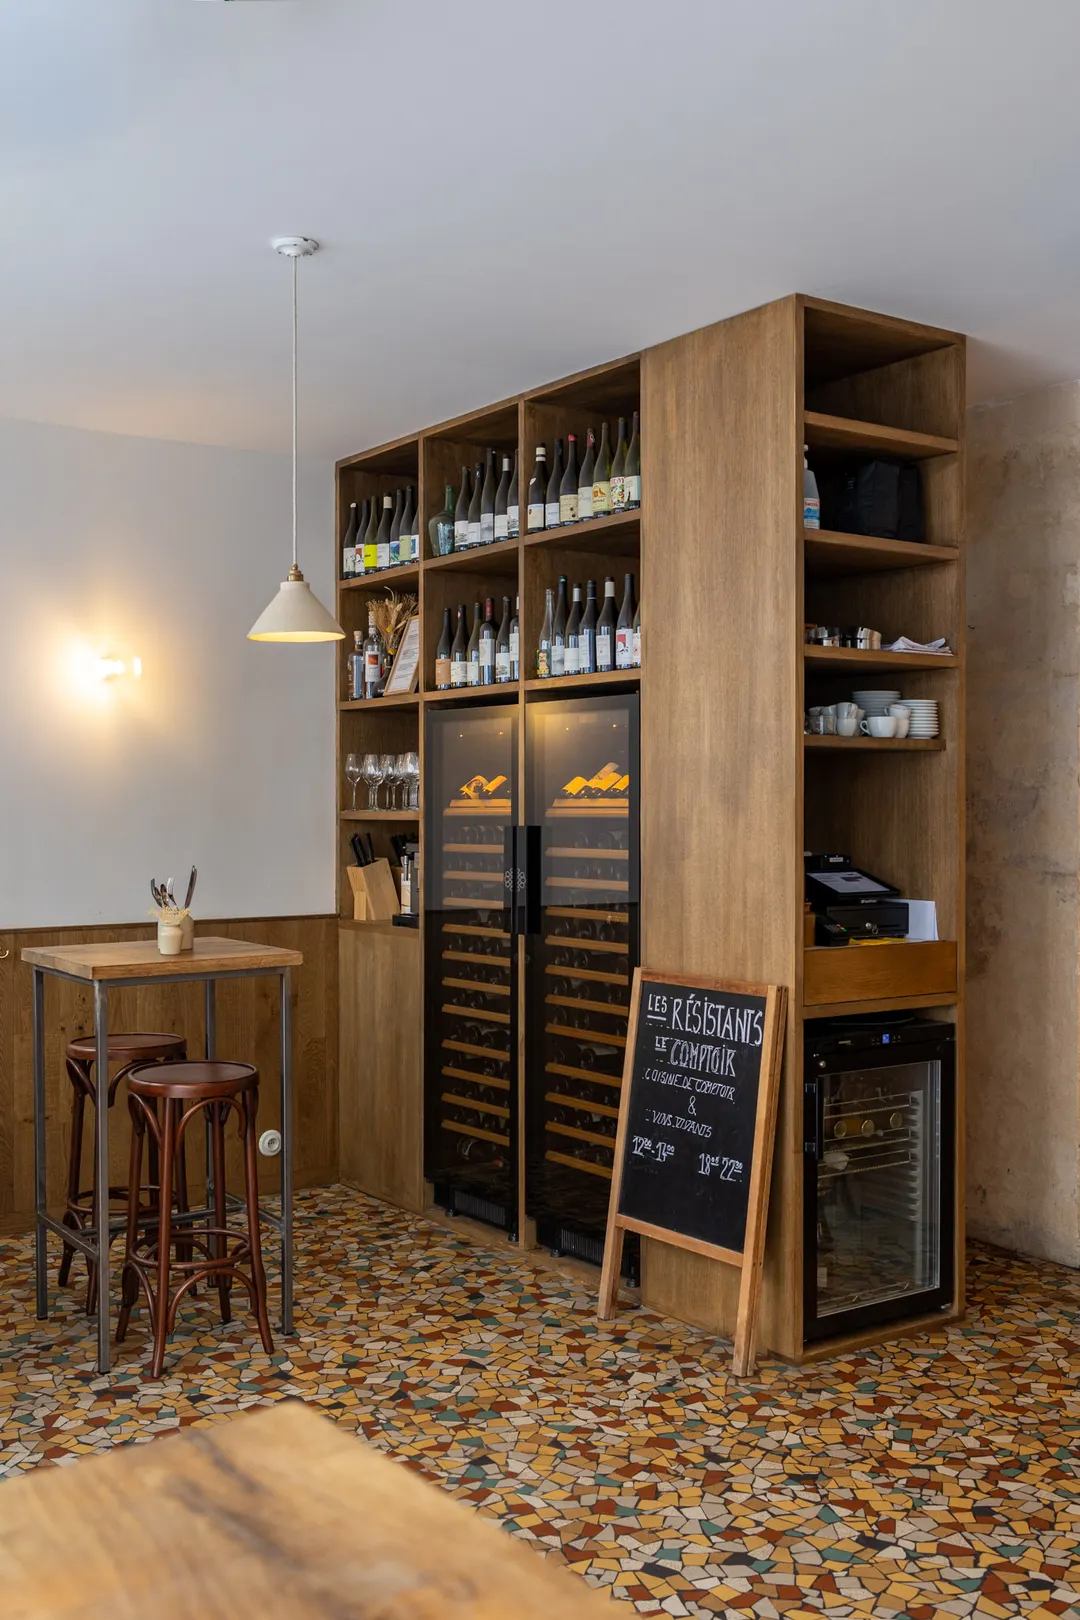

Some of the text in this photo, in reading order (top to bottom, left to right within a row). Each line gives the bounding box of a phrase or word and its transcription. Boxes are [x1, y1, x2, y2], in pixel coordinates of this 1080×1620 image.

[647, 993, 763, 1046] LES RÉSISTANTS
[655, 1035, 737, 1078] LE COMPTOIR
[644, 1068, 736, 1101] CUISINE DE COMPTOIR
[687, 1095, 697, 1116] &
